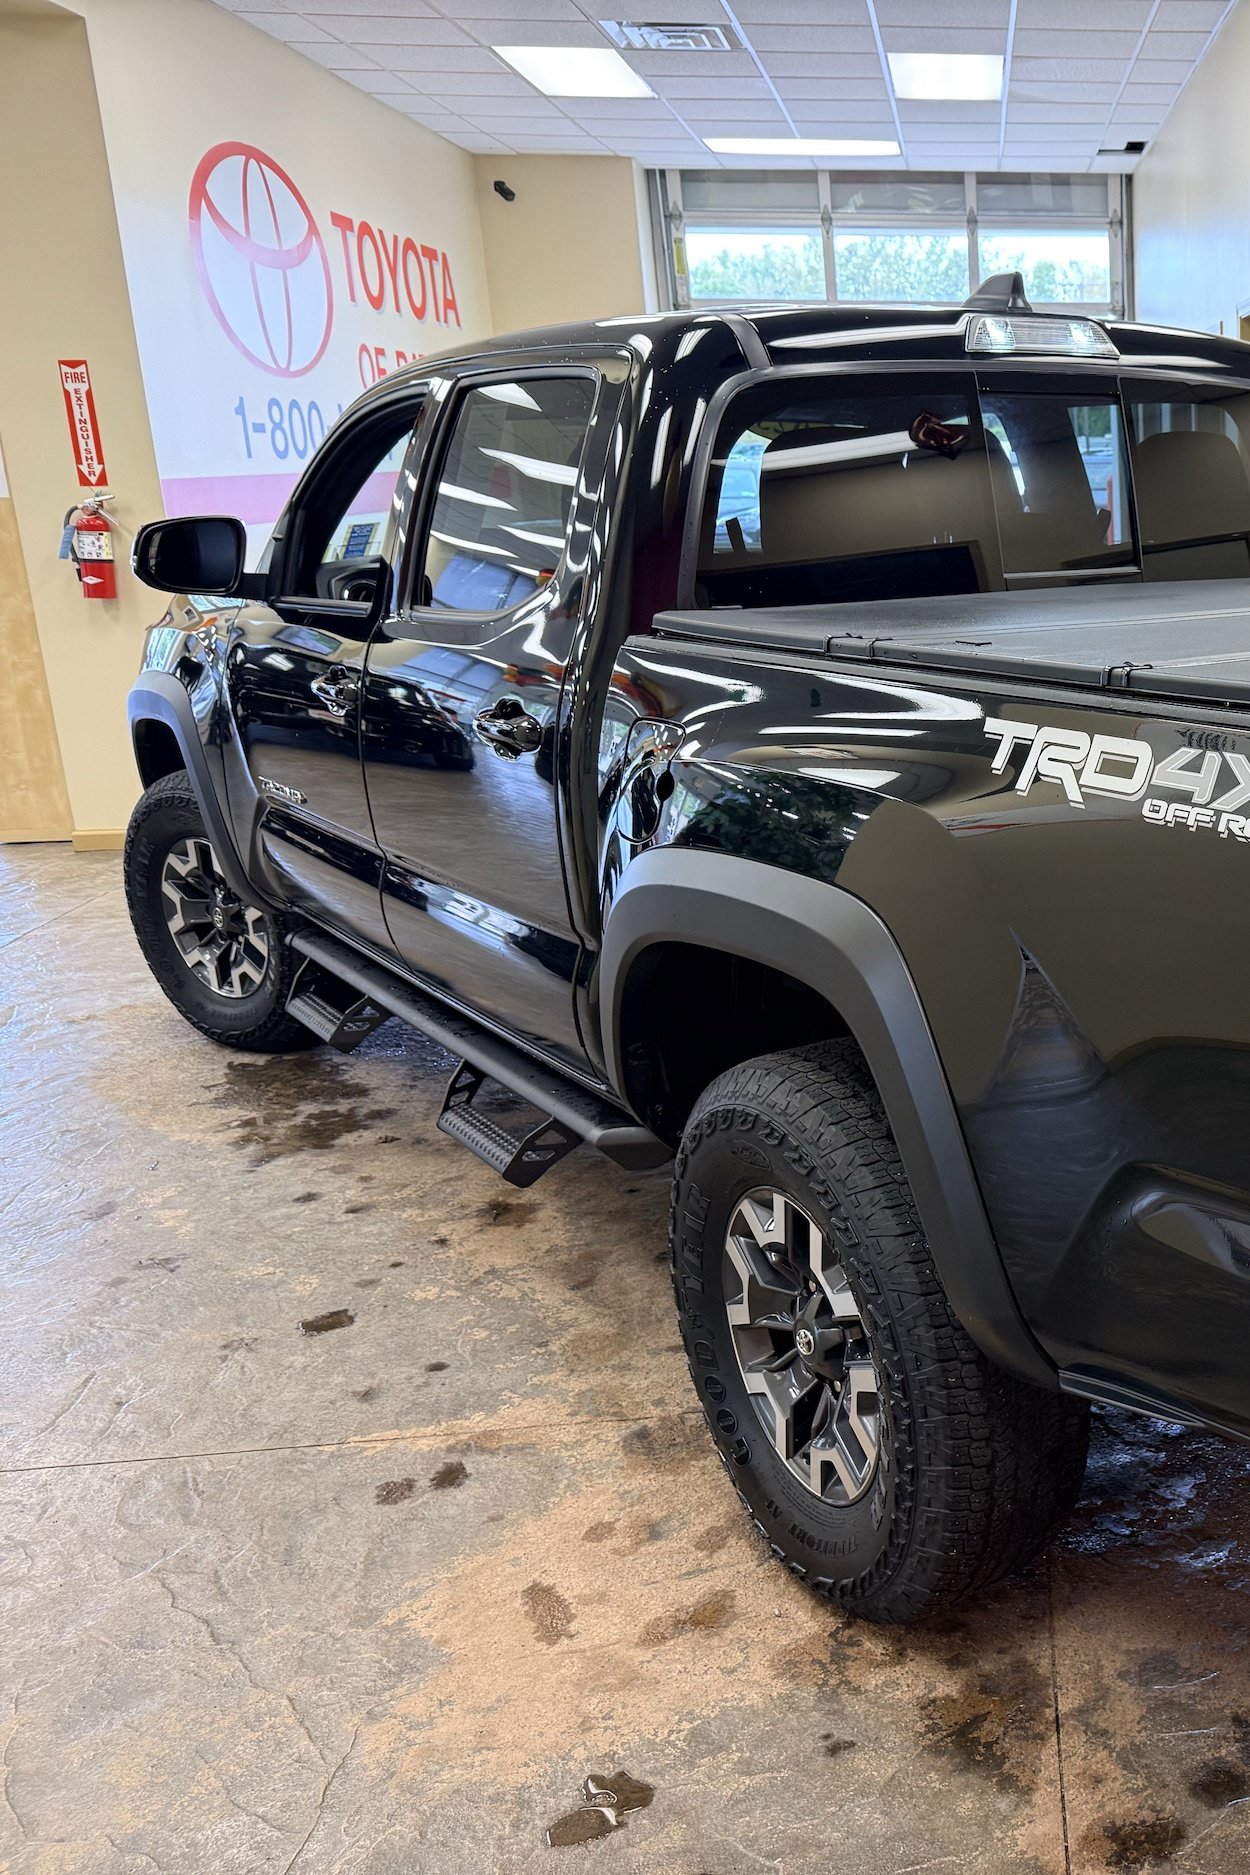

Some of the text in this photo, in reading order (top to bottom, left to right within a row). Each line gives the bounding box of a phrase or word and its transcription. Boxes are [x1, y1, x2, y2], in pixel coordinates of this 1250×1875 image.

[330, 210, 461, 328] TOYOTA
[63, 371, 87, 384] FIRE
[73, 387, 97, 477] EXTINGUISHER
[234, 395, 343, 460] 1-800
[983, 716, 1155, 810] TRD
[1141, 798, 1216, 832] OFF
